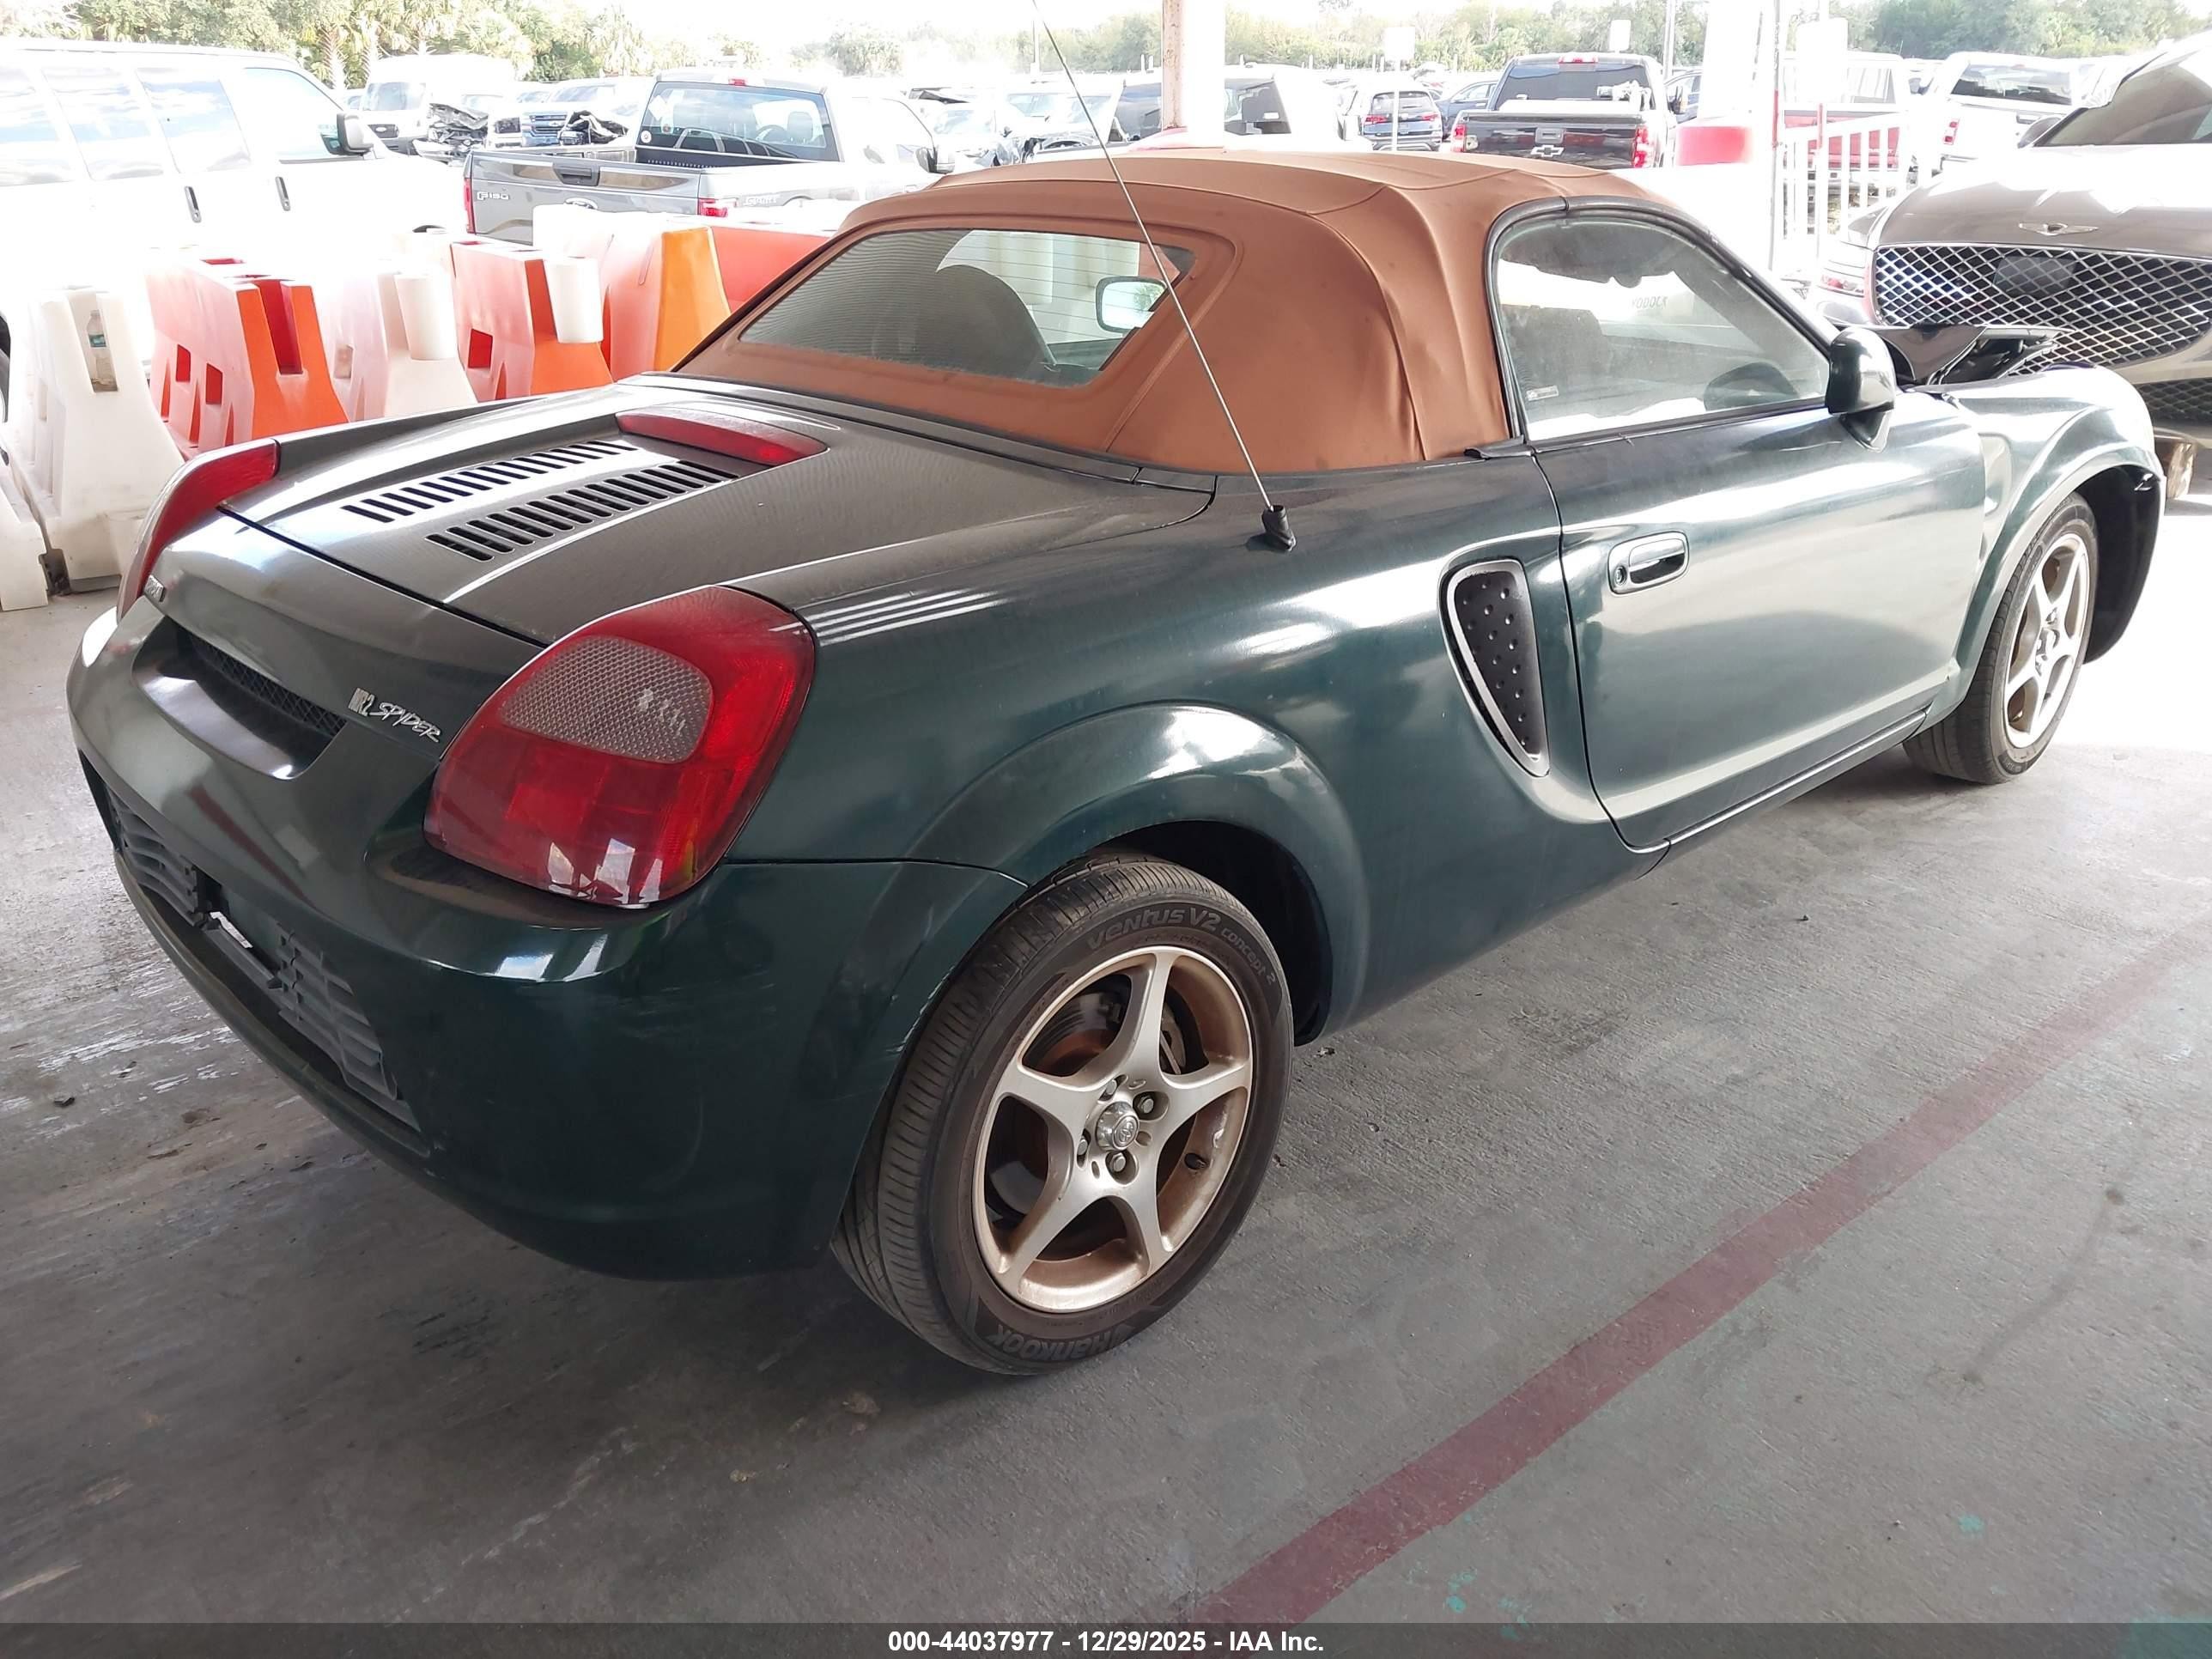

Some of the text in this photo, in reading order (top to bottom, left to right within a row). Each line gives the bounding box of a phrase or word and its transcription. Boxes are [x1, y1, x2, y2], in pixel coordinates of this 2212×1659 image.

[348, 687, 441, 743] MR2 SPYDER
[1189, 907, 1222, 932] V2
